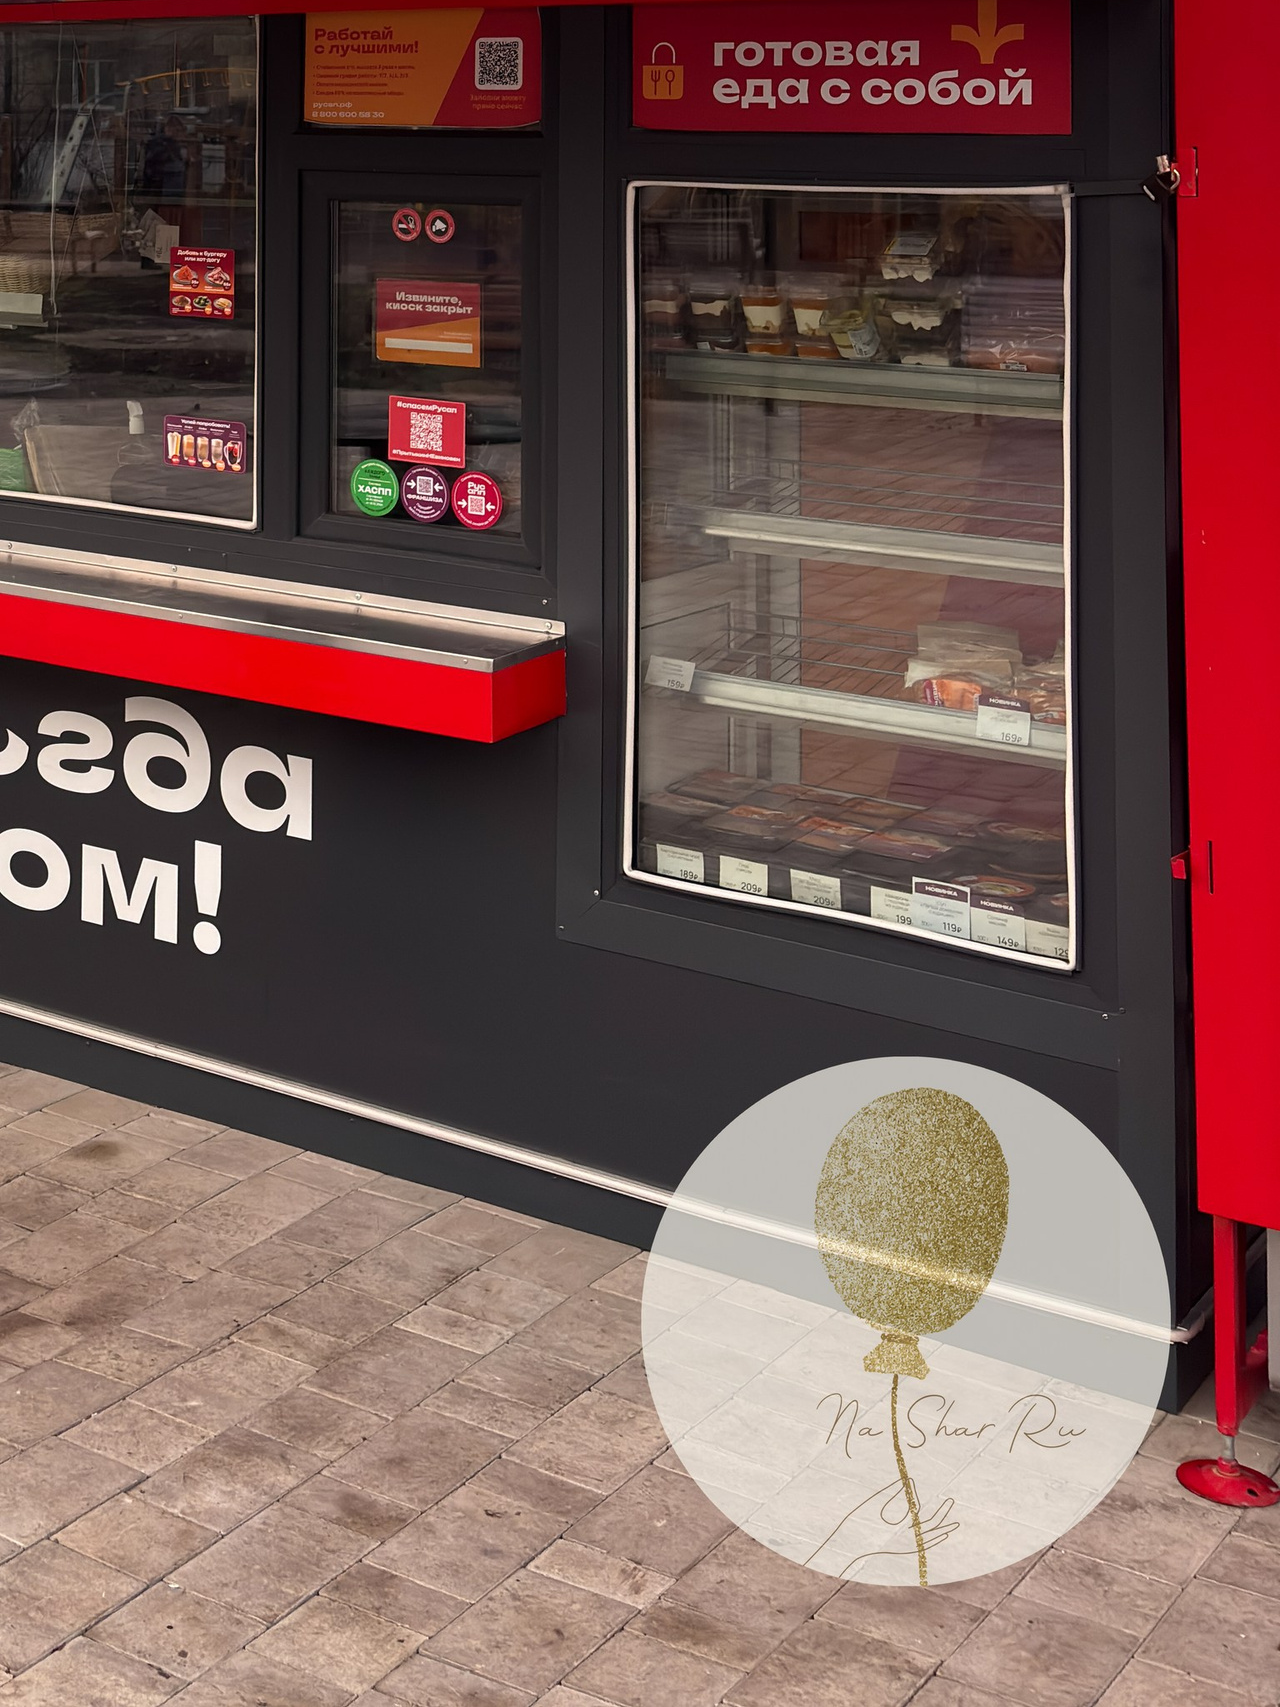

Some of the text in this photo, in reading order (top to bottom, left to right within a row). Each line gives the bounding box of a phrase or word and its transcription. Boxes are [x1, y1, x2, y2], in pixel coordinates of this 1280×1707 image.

[314, 26, 394, 41] Работай
[314, 40, 419, 58] с лучшими!
[713, 40, 920, 68] готовая
[712, 68, 1033, 110] еда с собой
[395, 291, 463, 307] Извините,
[385, 301, 473, 316] киоск закрыт
[357, 484, 392, 497] ХАСПП
[989, 697, 1022, 708] НОВИНКА
[924, 884, 959, 897] НОВИНКА
[980, 898, 1015, 912] НОВИНКА
